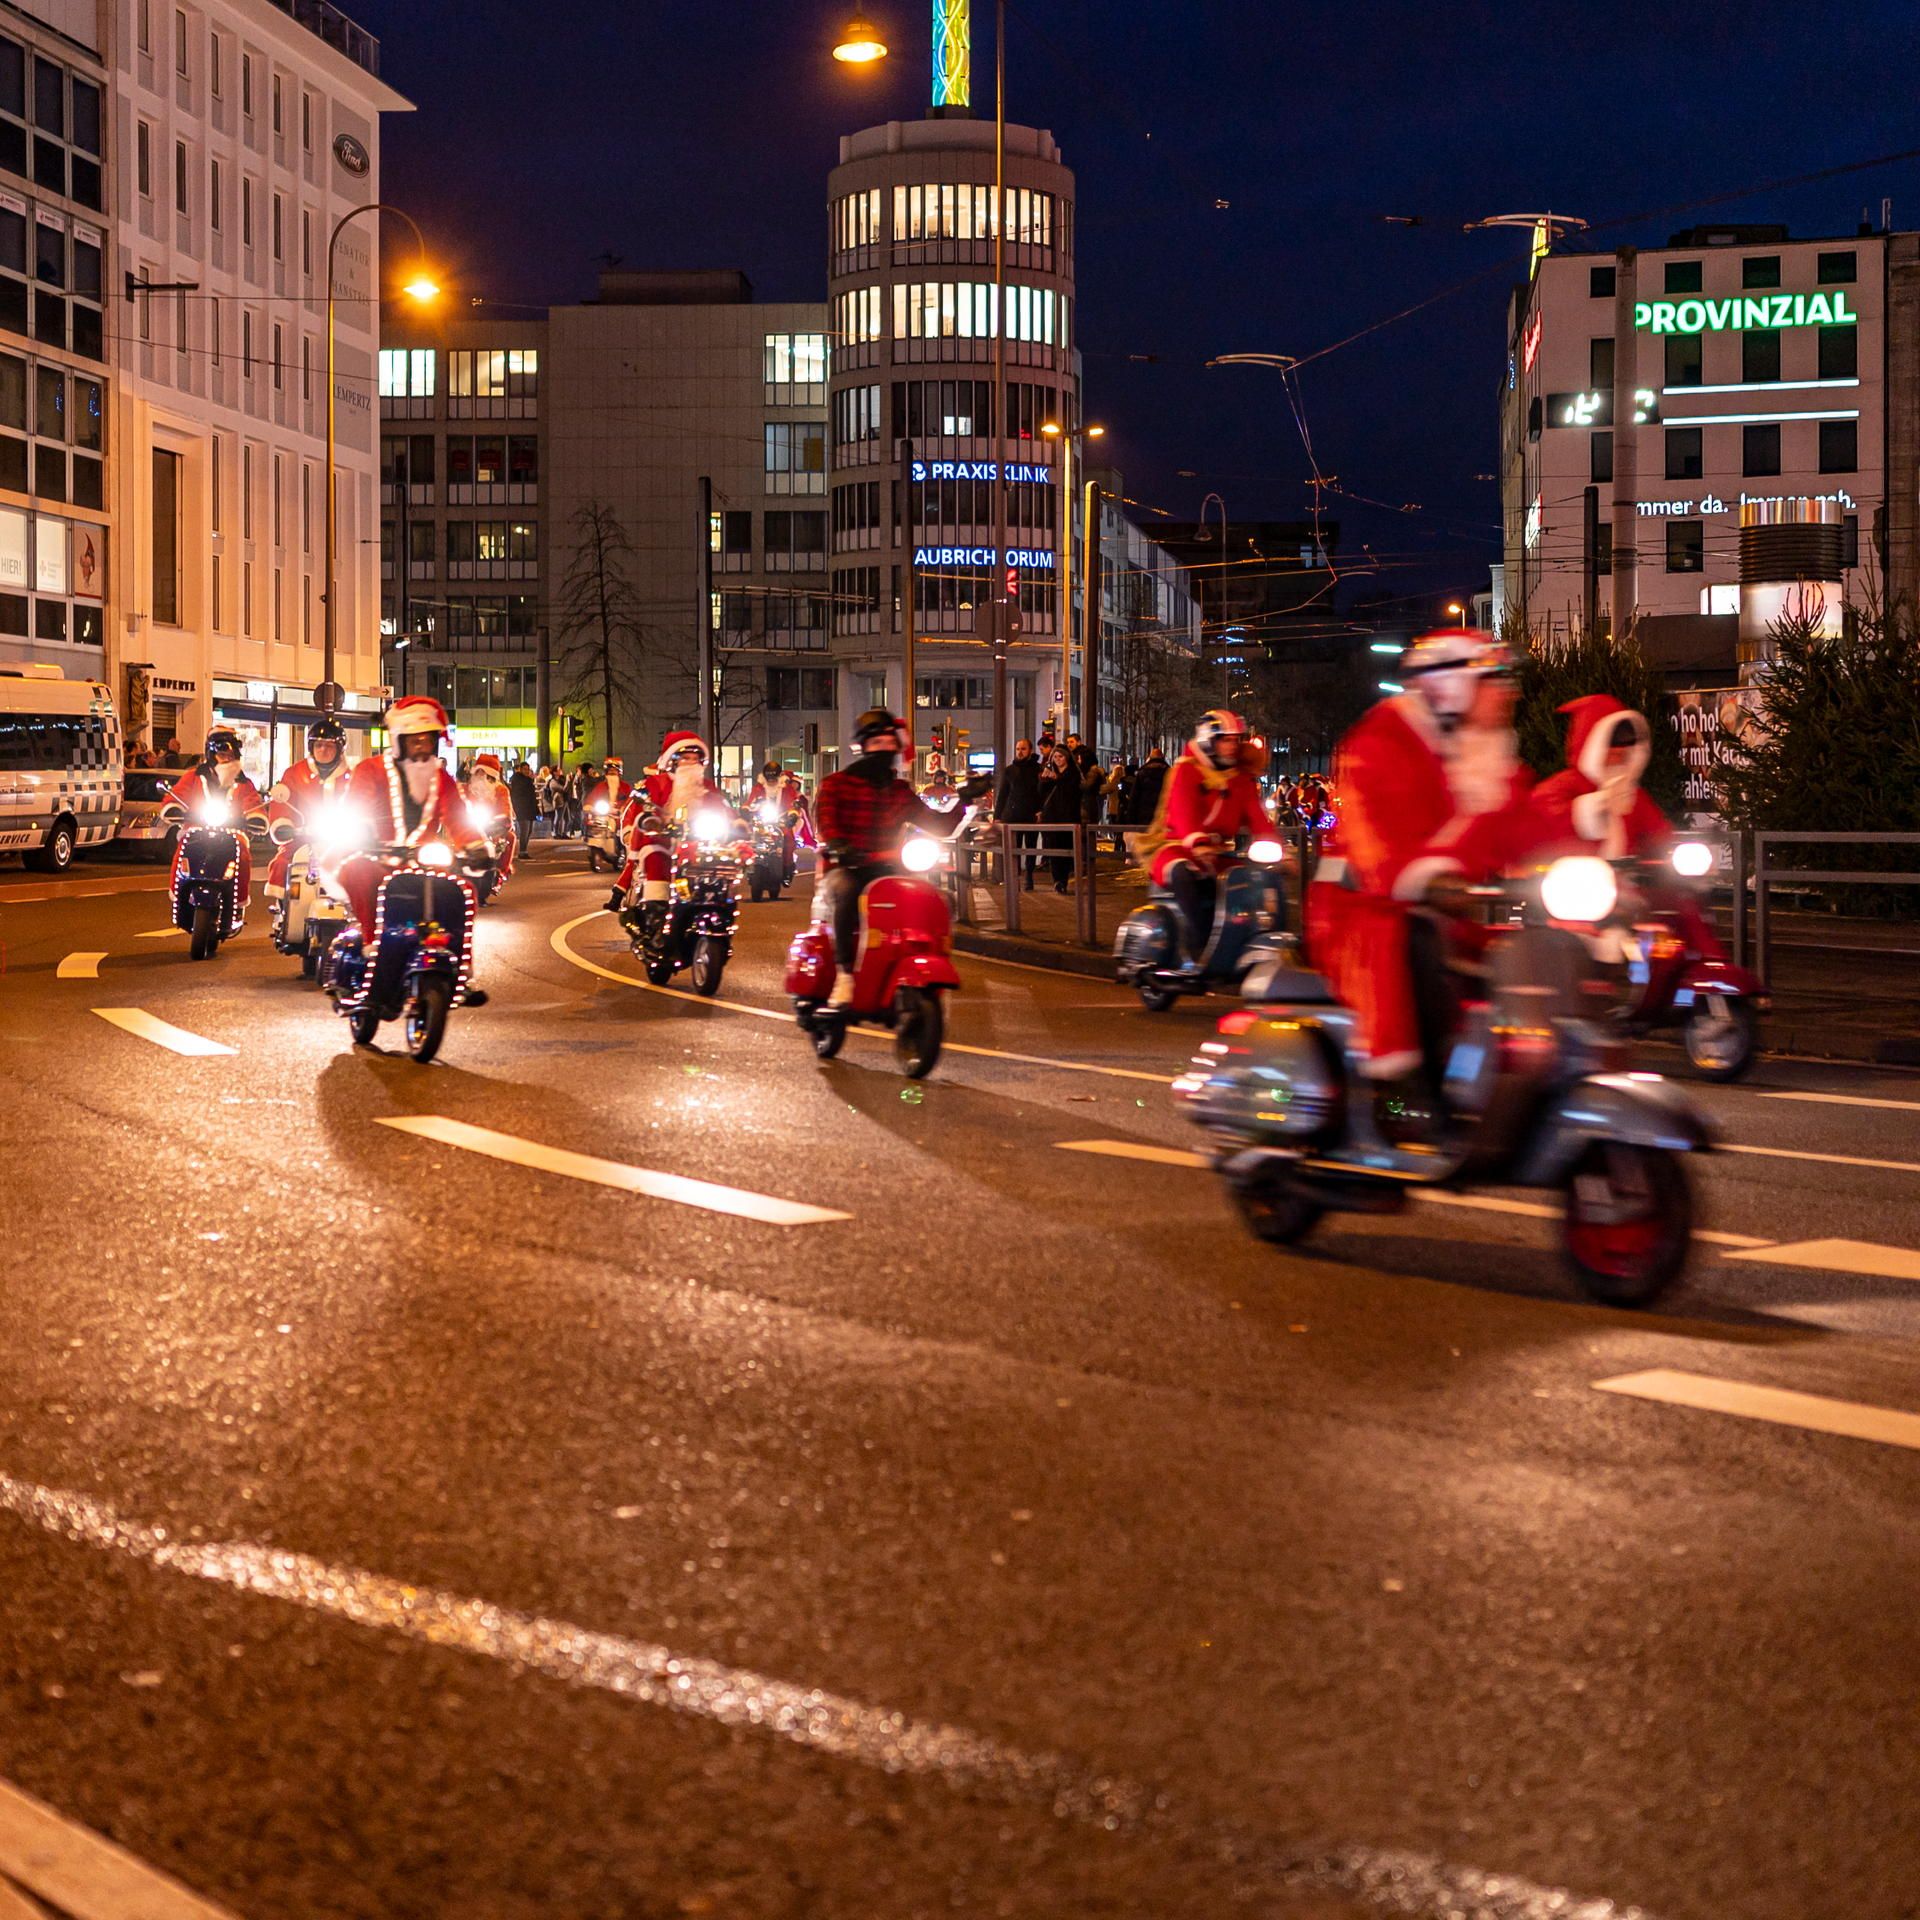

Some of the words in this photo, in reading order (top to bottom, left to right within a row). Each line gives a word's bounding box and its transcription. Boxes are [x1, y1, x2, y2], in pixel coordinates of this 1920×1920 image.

[341, 140, 361, 169] Ford
[1636, 291, 1857, 334] PROVINZIAL
[1636, 500, 1694, 516] mmer
[1700, 493, 1729, 514] da.
[1, 557, 22, 576] HIER!
[153, 677, 196, 692] EMPERTZ
[1681, 707, 1697, 733] ho
[1699, 706, 1719, 733] ho!
[1690, 740, 1711, 766] mit
